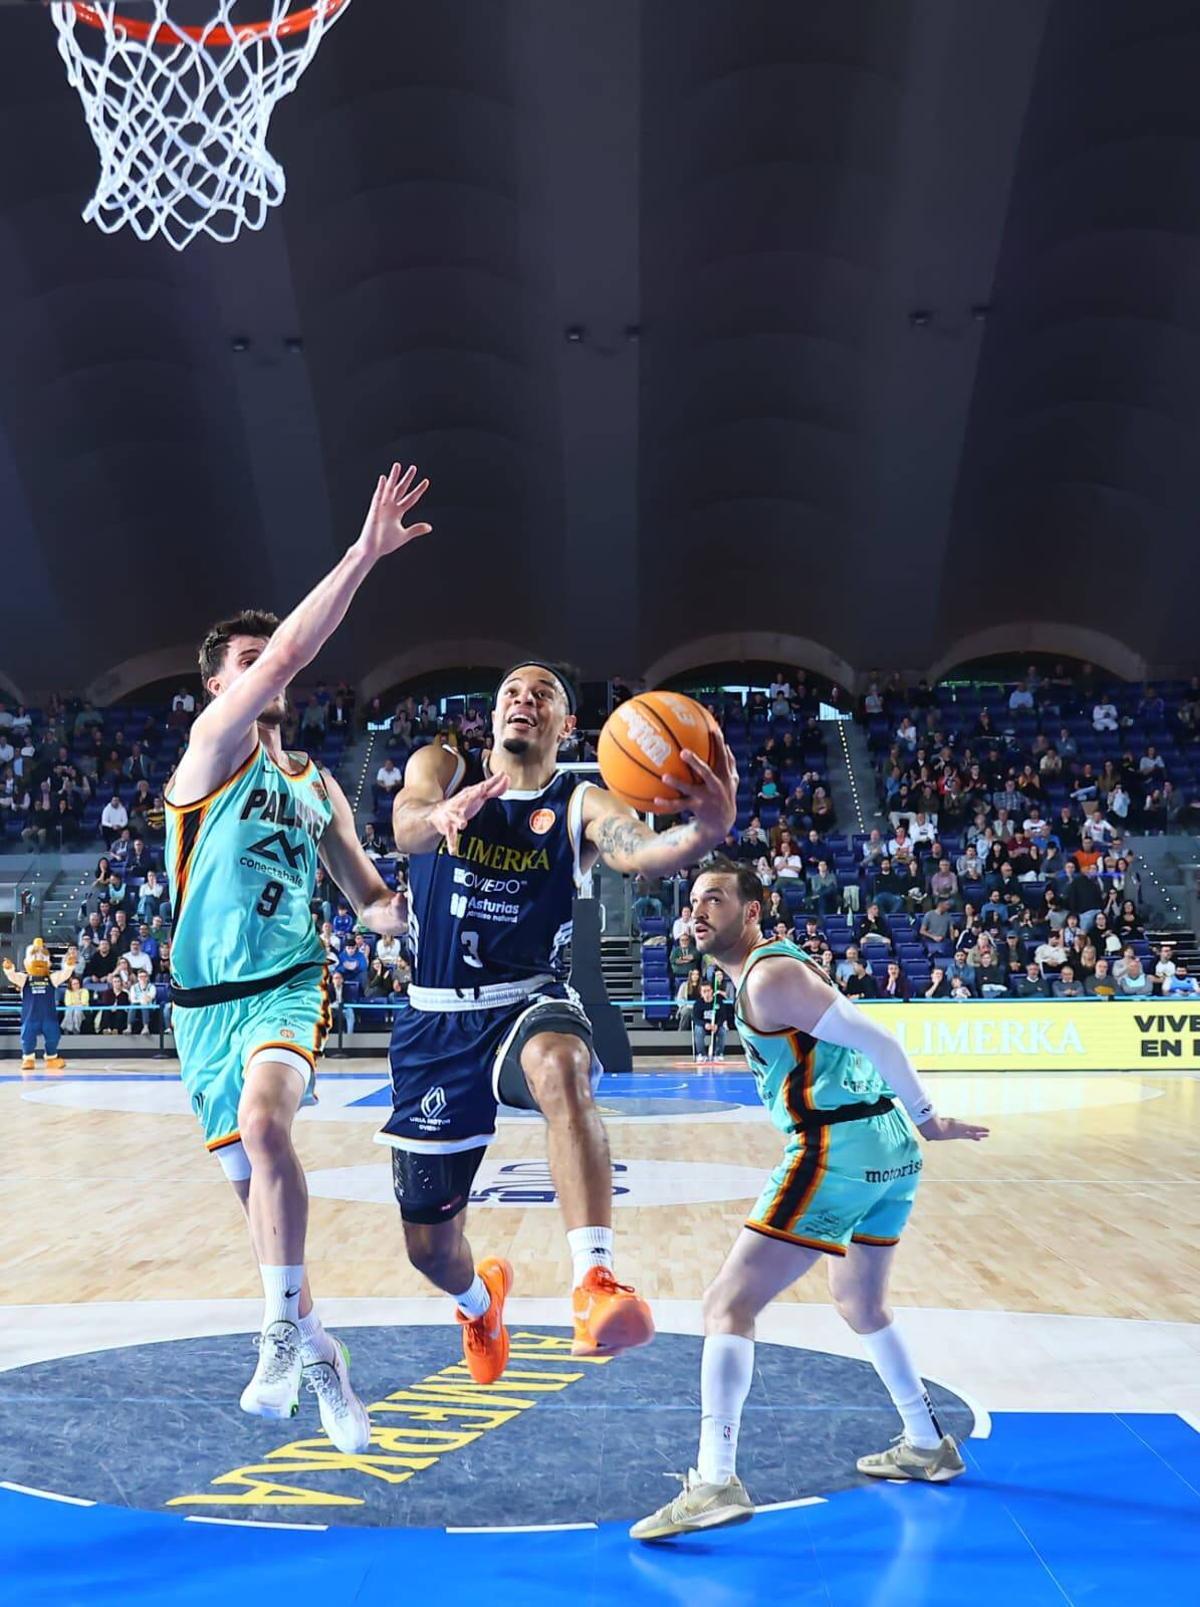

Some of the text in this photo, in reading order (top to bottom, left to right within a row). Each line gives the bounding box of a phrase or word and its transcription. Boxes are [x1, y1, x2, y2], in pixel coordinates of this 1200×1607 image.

[257, 881, 284, 917] 9
[463, 871, 520, 894] OVIEDO
[468, 896, 520, 915] Asturias
[460, 931, 484, 968] 3
[895, 1020, 1088, 1056] LIMERKA
[1141, 1040, 1182, 1057] EN
[165, 1331, 614, 1505] ALIMERKA
